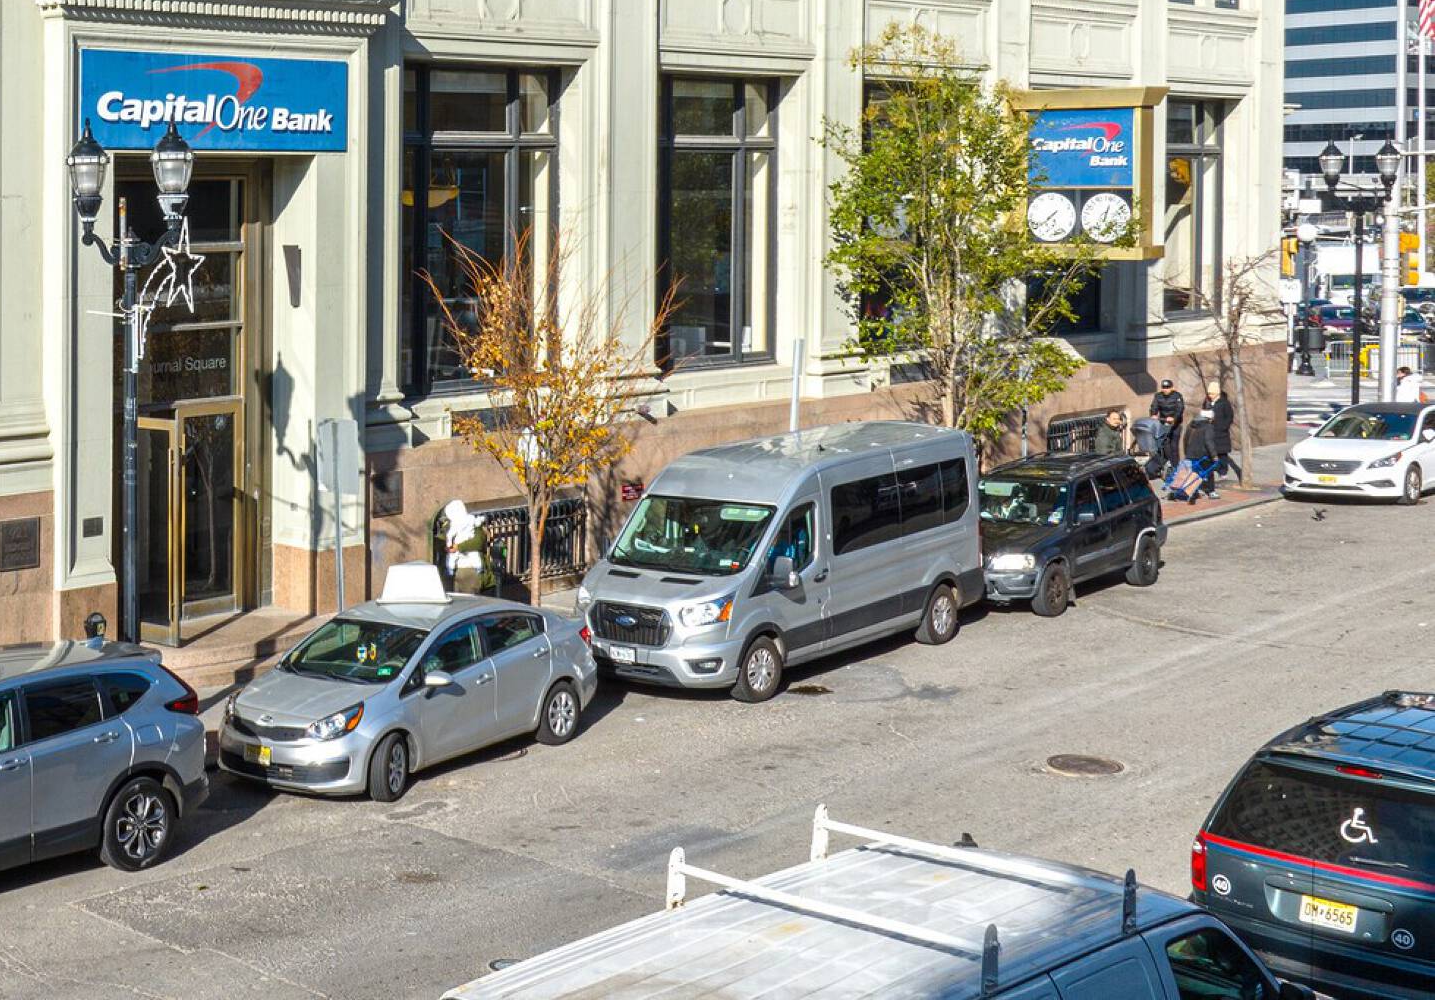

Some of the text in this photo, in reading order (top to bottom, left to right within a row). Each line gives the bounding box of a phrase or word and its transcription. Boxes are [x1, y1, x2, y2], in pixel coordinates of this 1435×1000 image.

[270, 107, 333, 134] Bank
[1089, 155, 1129, 167] Bank
[184, 356, 227, 374] Square
[1394, 932, 1411, 945] 40
